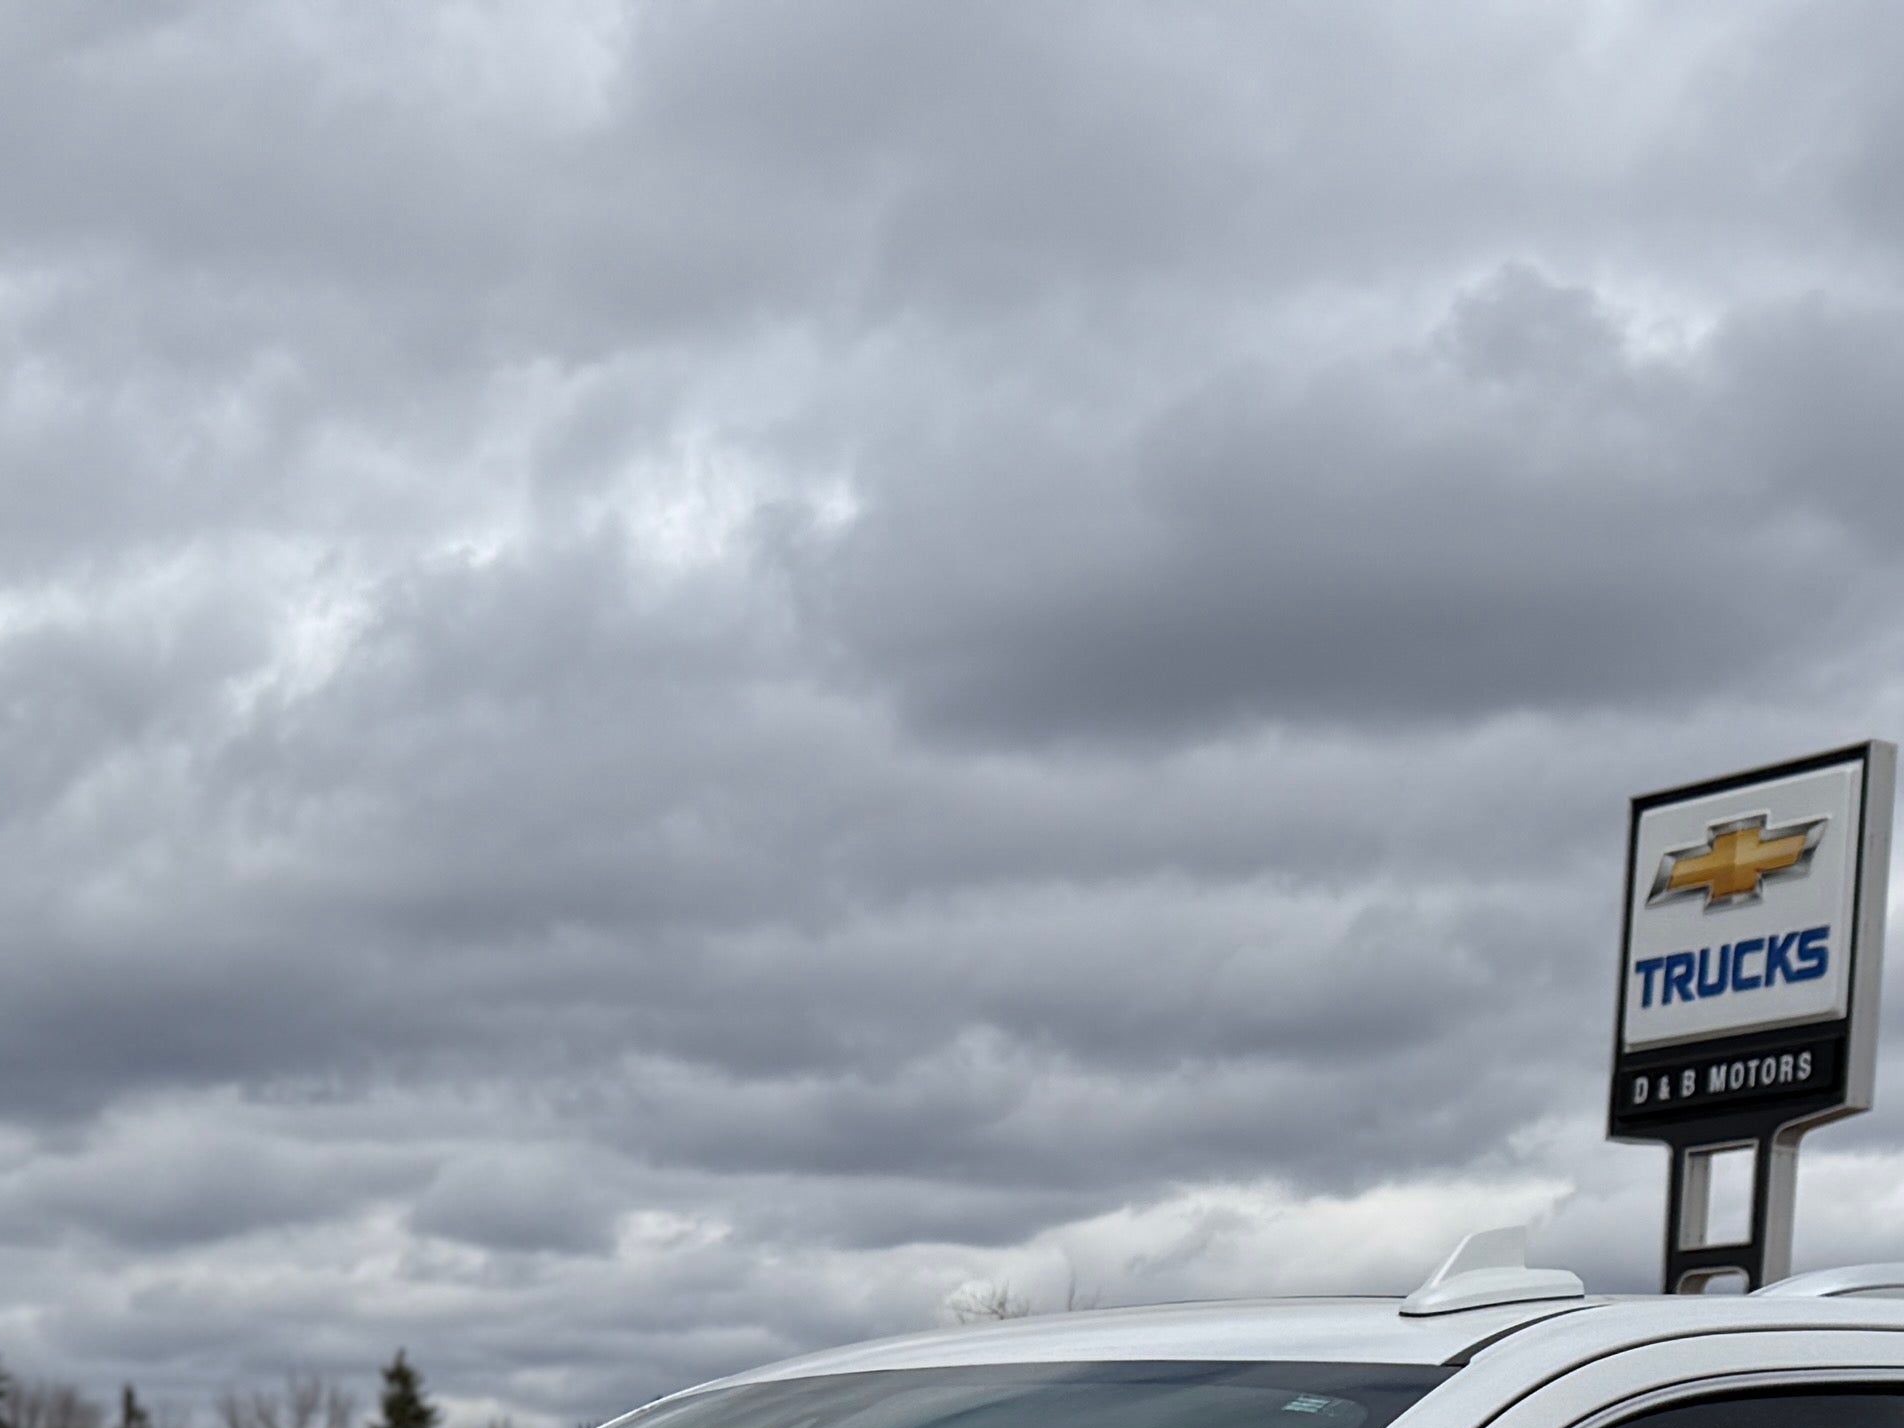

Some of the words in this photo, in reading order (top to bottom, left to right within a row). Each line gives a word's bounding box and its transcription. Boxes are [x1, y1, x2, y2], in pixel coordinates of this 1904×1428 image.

[1635, 925, 1830, 1008] TRUCKS
[1633, 1076, 1649, 1104] D
[1658, 1074, 1671, 1100] &
[1681, 1068, 1696, 1098] B
[1708, 1050, 1813, 1094] MOTORS
